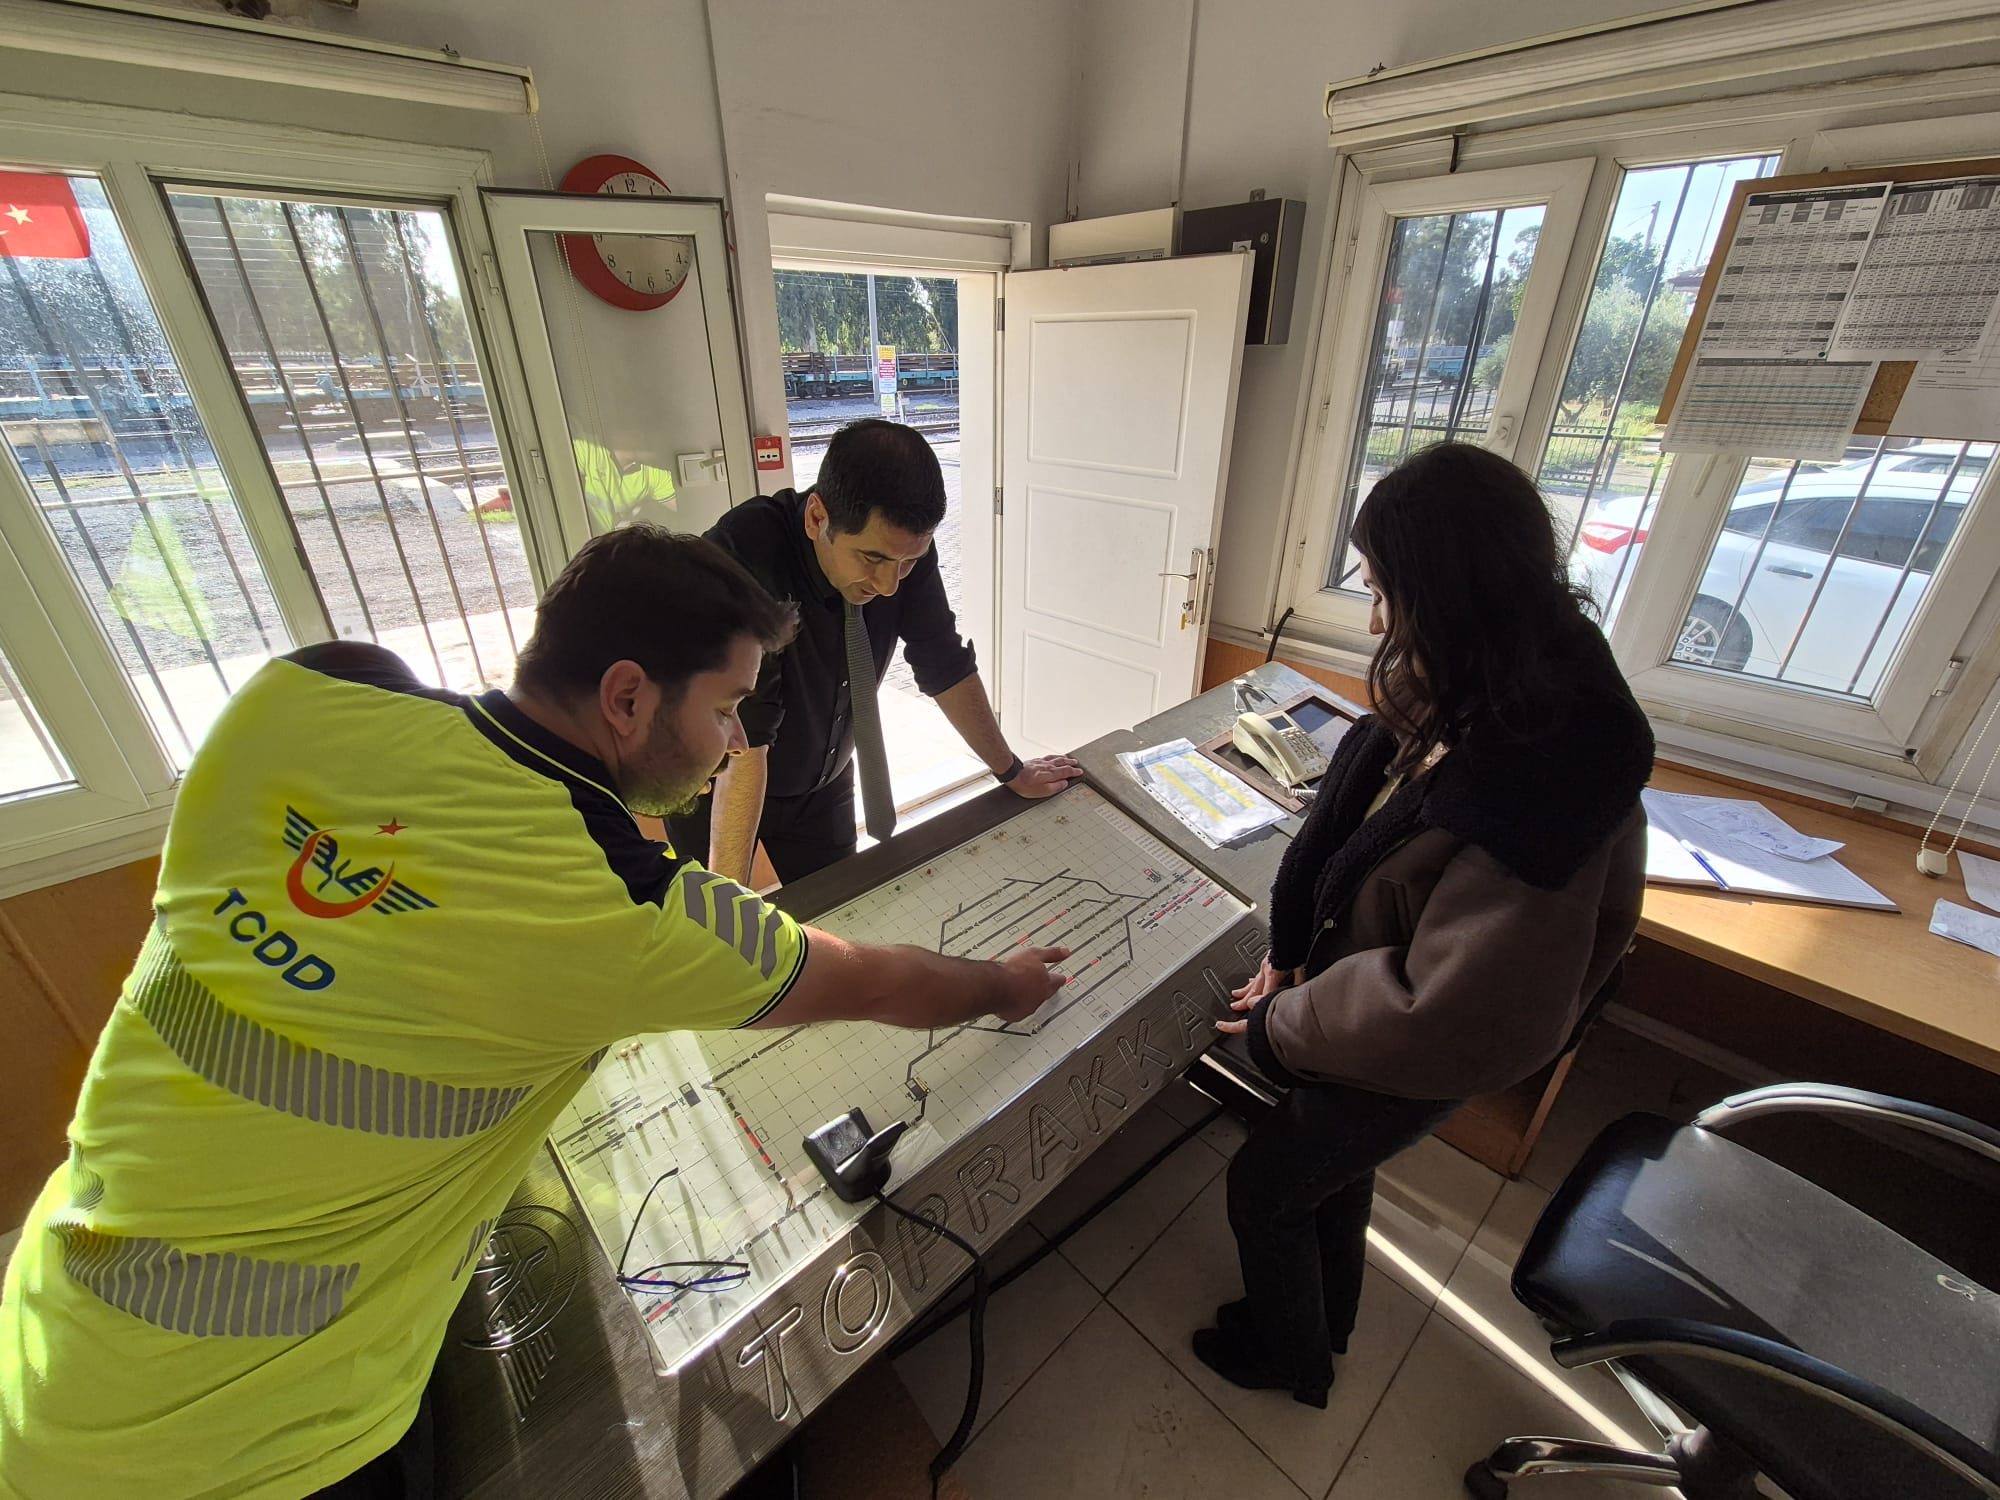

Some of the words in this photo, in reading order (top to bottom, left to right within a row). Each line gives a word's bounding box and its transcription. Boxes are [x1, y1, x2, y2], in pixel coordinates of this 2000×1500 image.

[624, 178, 637, 193] 12
[607, 254, 616, 268] 8
[676, 252, 682, 265] 4
[626, 271, 633, 284] 7
[647, 275, 655, 289] 6
[664, 269, 672, 282] 5
[213, 887, 336, 991] TCDD
